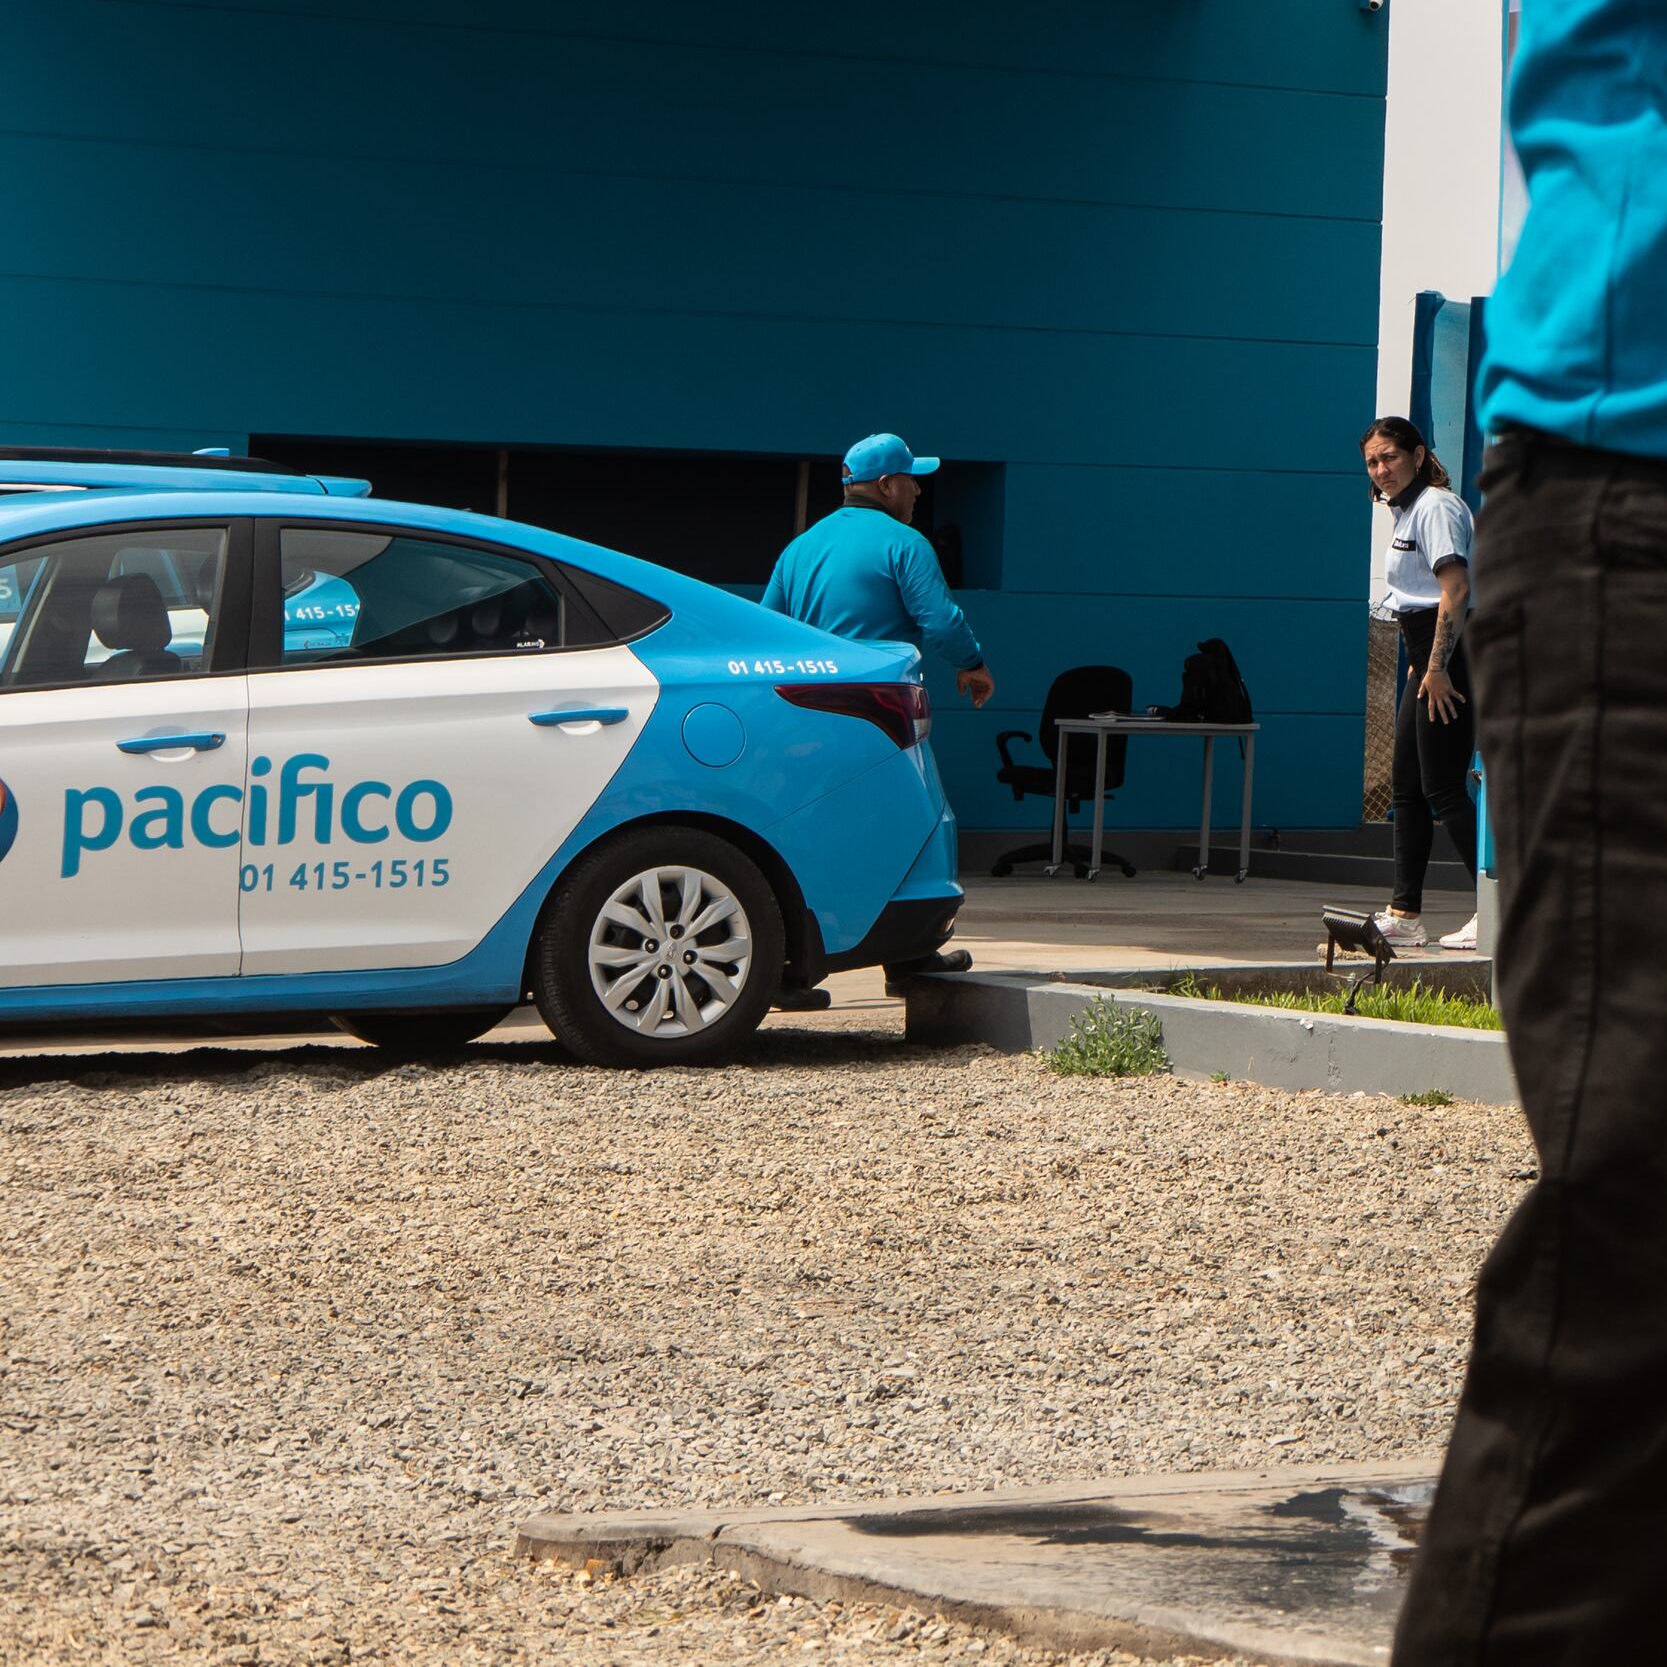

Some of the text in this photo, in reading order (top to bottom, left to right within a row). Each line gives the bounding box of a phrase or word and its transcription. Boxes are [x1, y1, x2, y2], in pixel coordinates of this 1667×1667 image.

[727, 660, 839, 675] 01 415-1515
[60, 752, 453, 879] pacifico
[239, 858, 451, 893] 01 415-1515
